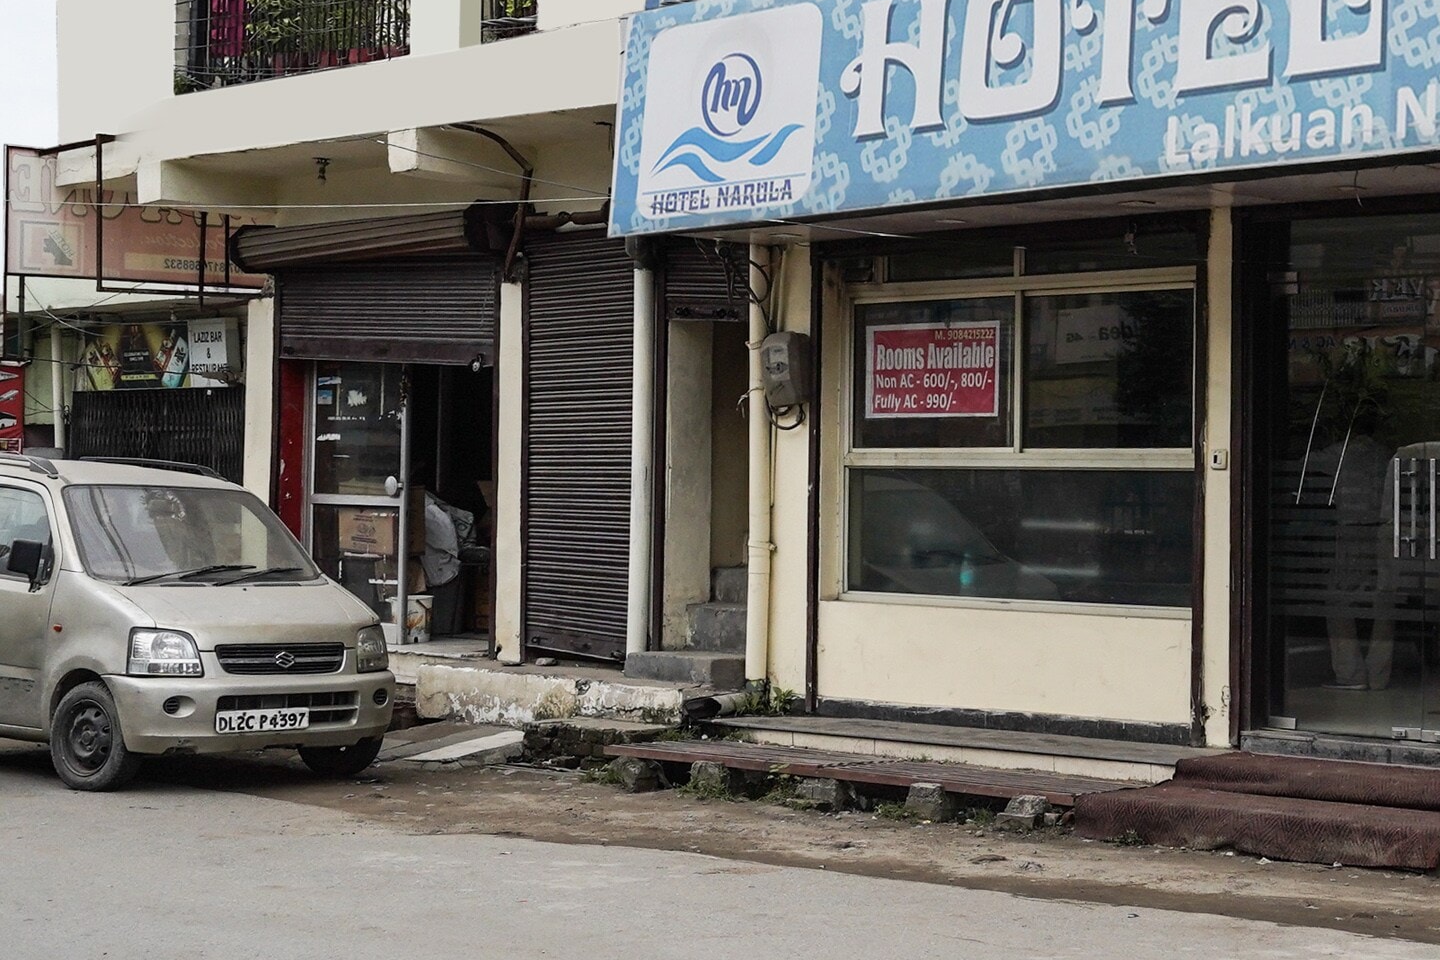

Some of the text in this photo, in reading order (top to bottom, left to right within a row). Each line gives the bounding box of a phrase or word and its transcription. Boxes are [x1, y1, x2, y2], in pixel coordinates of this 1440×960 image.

[1166, 103, 1376, 164] Lalkuan
[651, 179, 793, 215] HOTEL NARULA
[210, 331, 223, 343] BAR
[934, 330, 946, 340] M.
[206, 347, 211, 359] &
[876, 341, 994, 371] Rooms Available
[876, 374, 897, 389] Non
[900, 373, 914, 388] AC
[961, 370, 992, 390] 800/-
[875, 393, 901, 412] Fully
[903, 394, 917, 409] AC
[926, 392, 957, 411] 990/-
[219, 715, 256, 731] DL2C
